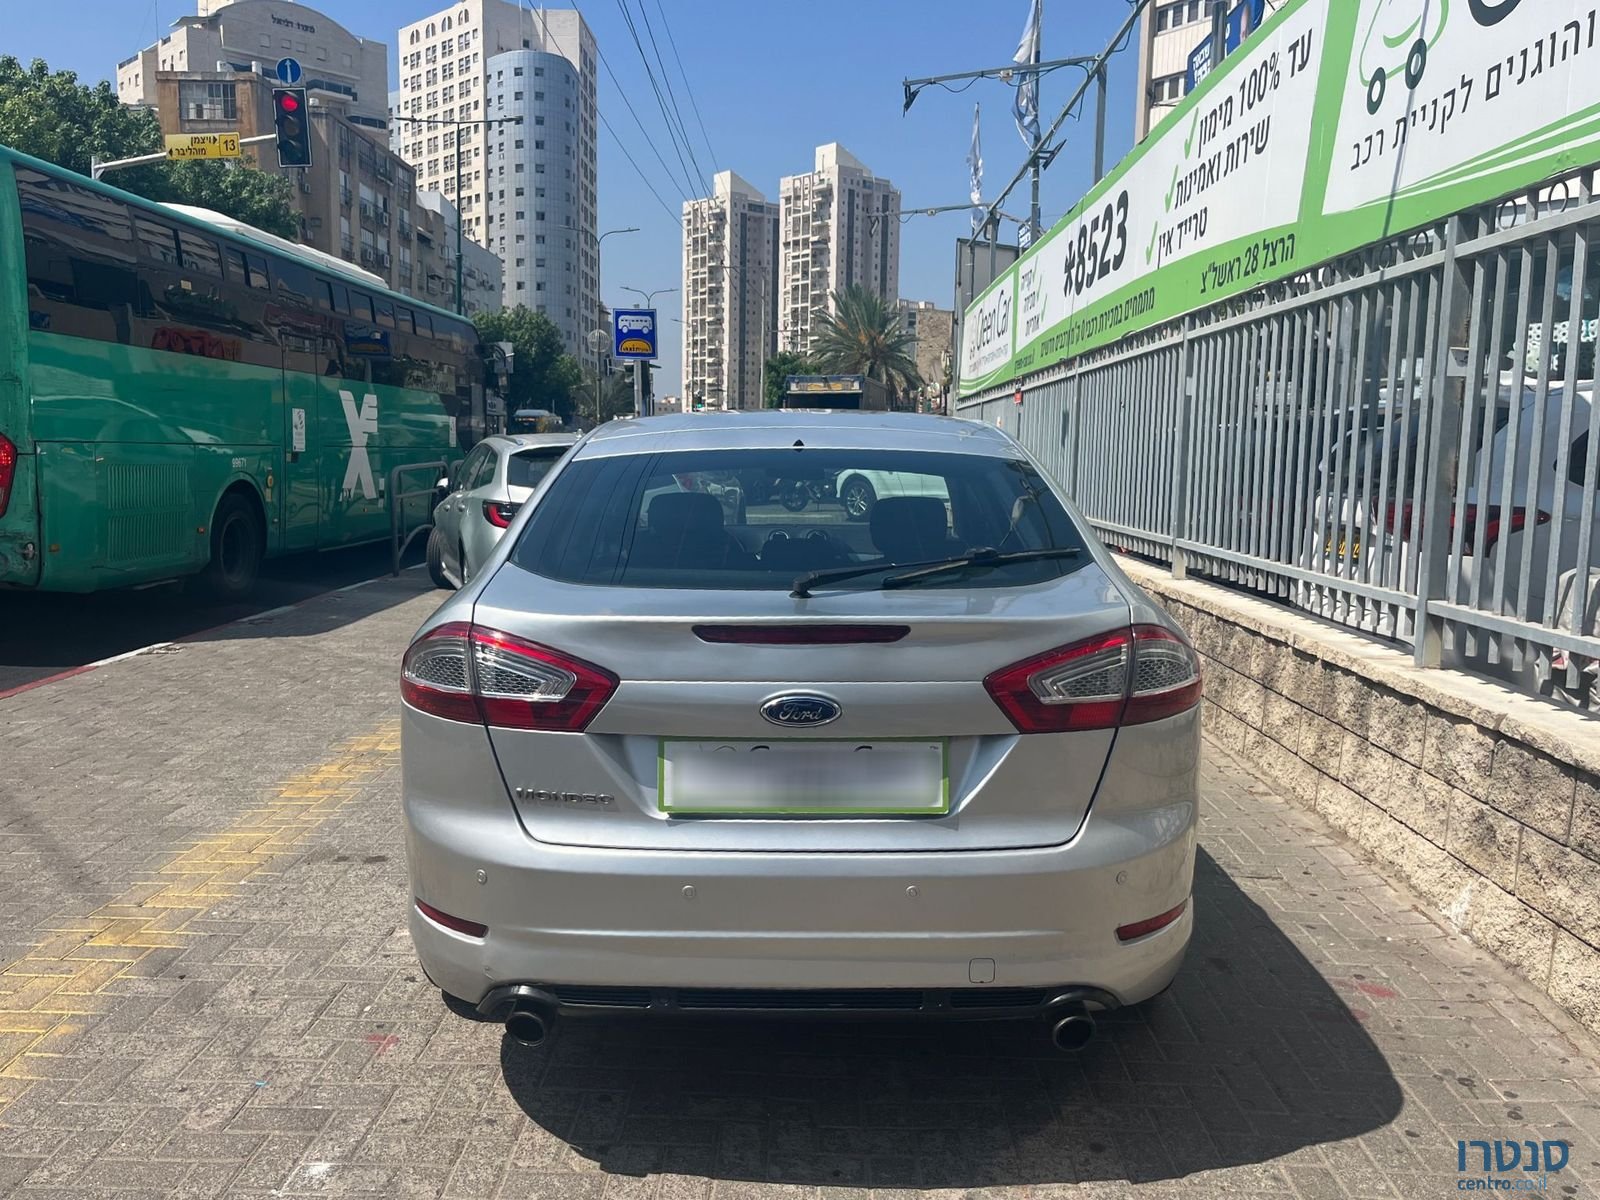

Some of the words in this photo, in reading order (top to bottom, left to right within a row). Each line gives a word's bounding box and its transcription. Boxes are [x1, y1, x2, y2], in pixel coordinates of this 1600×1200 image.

[1287, 28, 1313, 78] עד
[1485, 9, 1596, 102] והוגנים
[1239, 51, 1280, 117] 100%
[1197, 95, 1233, 159] מימון
[1392, 74, 1474, 150] לקניית
[174, 145, 207, 156] מוהליבר
[190, 135, 211, 147] ויצמן
[222, 139, 236, 152] 13
[1223, 114, 1271, 178] שירות
[1350, 128, 1385, 171] רכב
[1174, 151, 1221, 210] ואמינות
[1157, 227, 1174, 270] אין
[1176, 206, 1208, 250] טרייד
[1243, 242, 1260, 276] 28
[1262, 233, 1296, 270] הרצל
[1124, 286, 1155, 321] מתמחים
[779, 702, 822, 720] Ford
[515, 786, 615, 805] MONDEO
